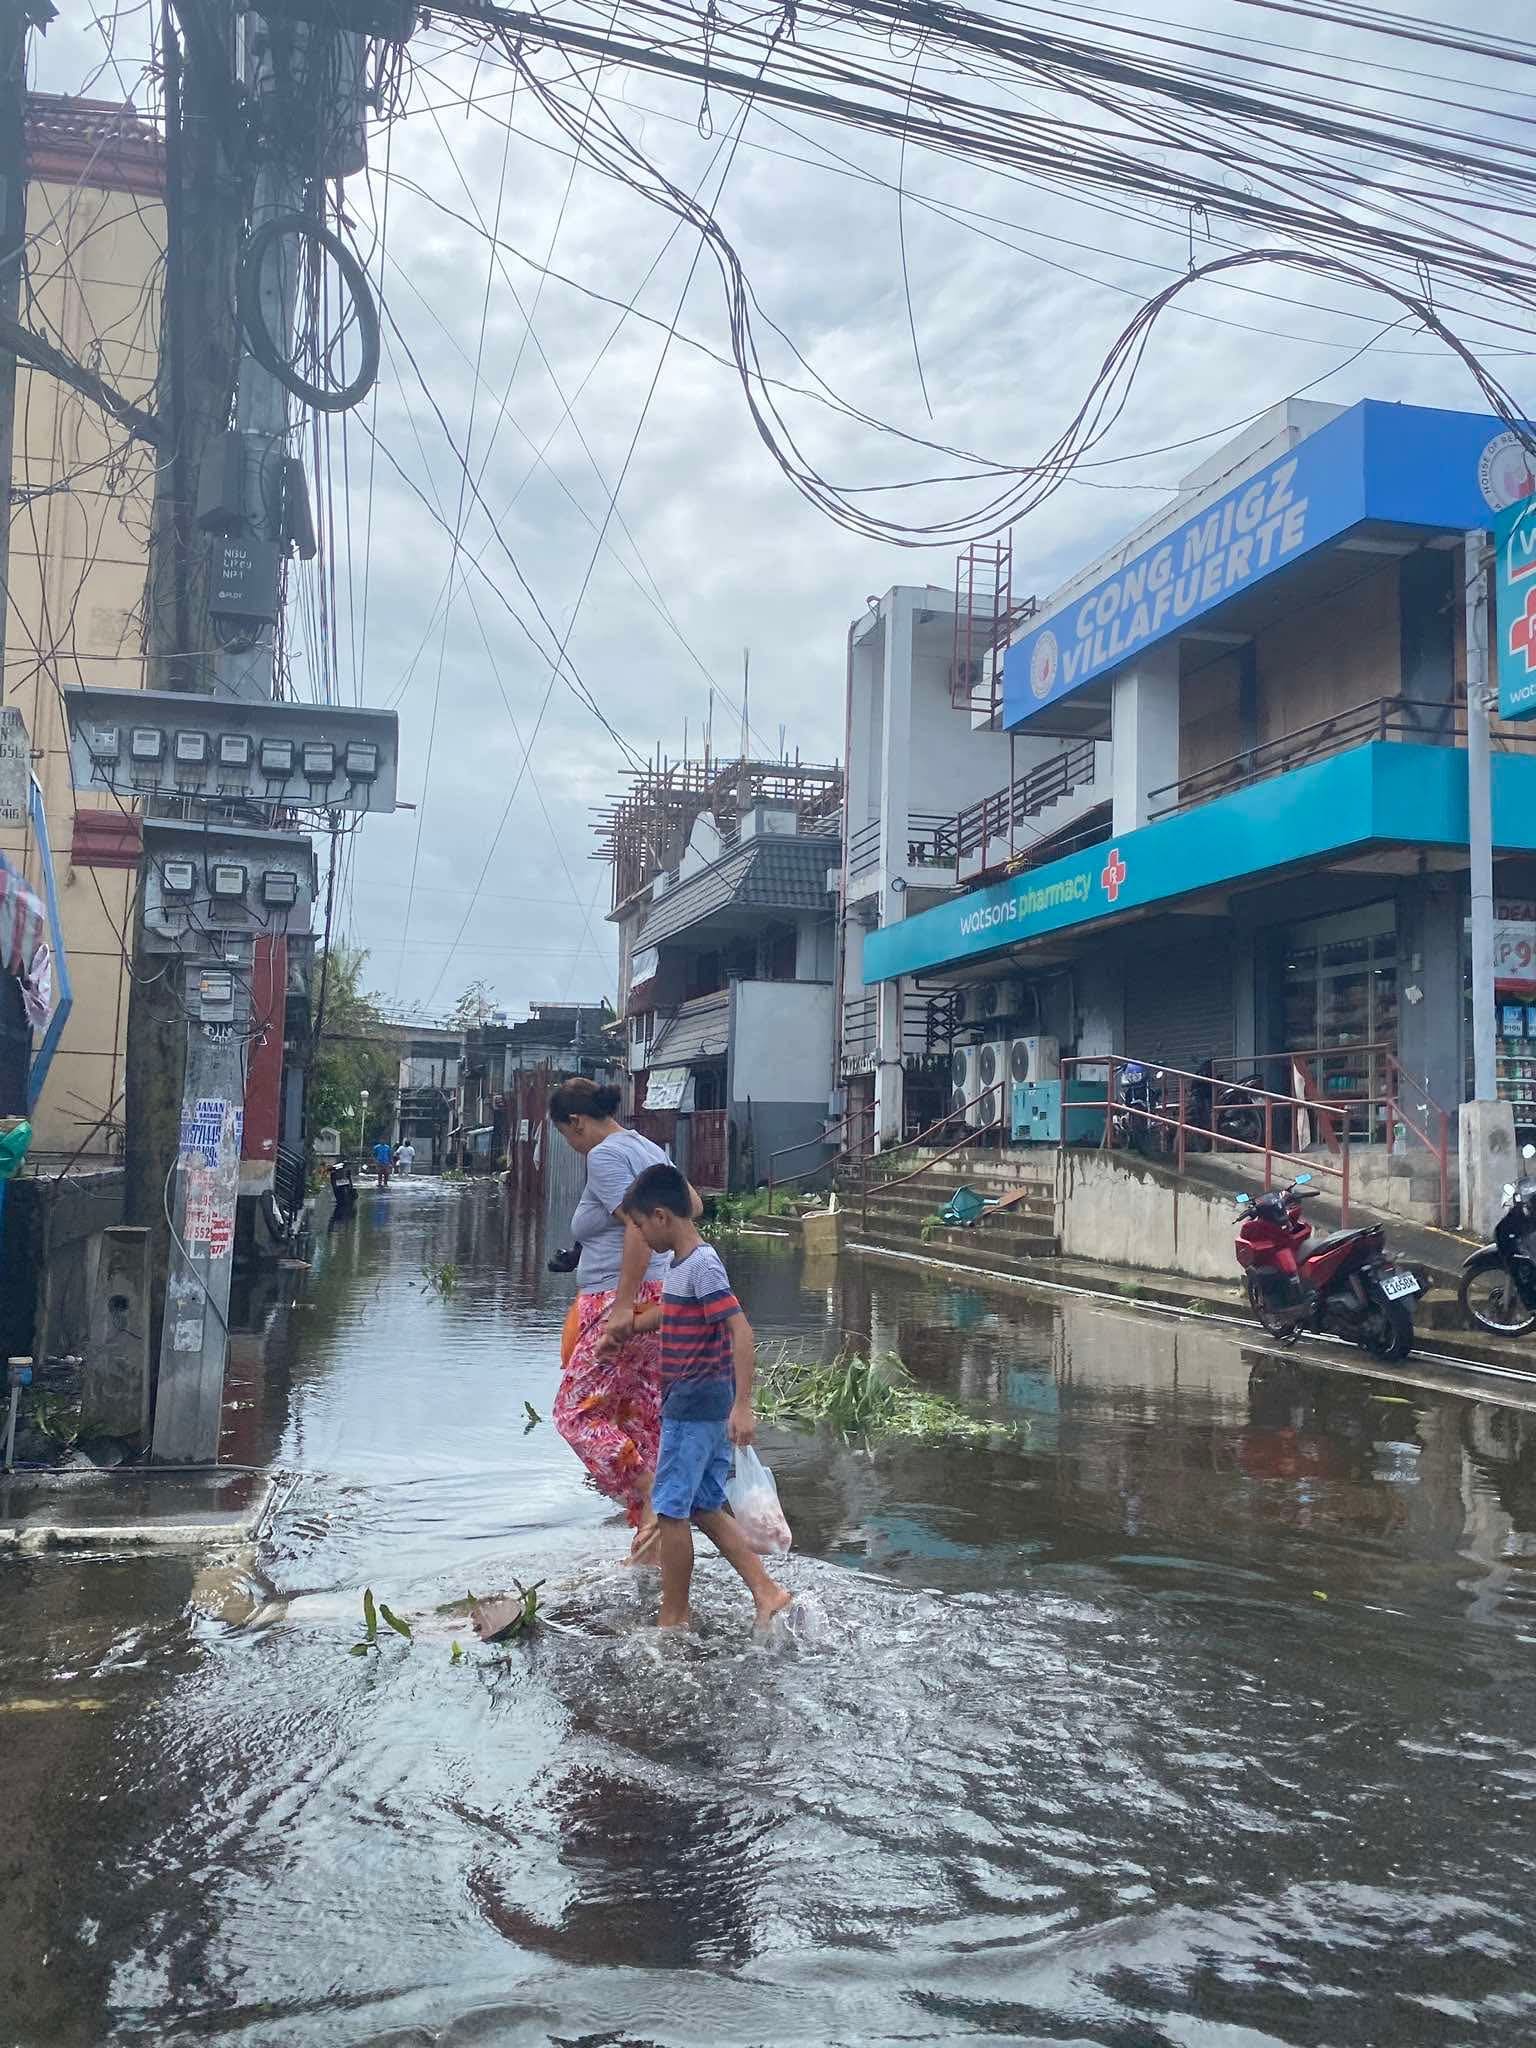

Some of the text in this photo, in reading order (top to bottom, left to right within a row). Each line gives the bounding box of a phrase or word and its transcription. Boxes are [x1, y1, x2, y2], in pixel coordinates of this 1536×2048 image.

[1182, 457, 1298, 572] MIGZ
[1062, 497, 1308, 684] VILLAFUERTE
[960, 899, 1017, 936] watsons
[1018, 872, 1092, 922] pharmacy
